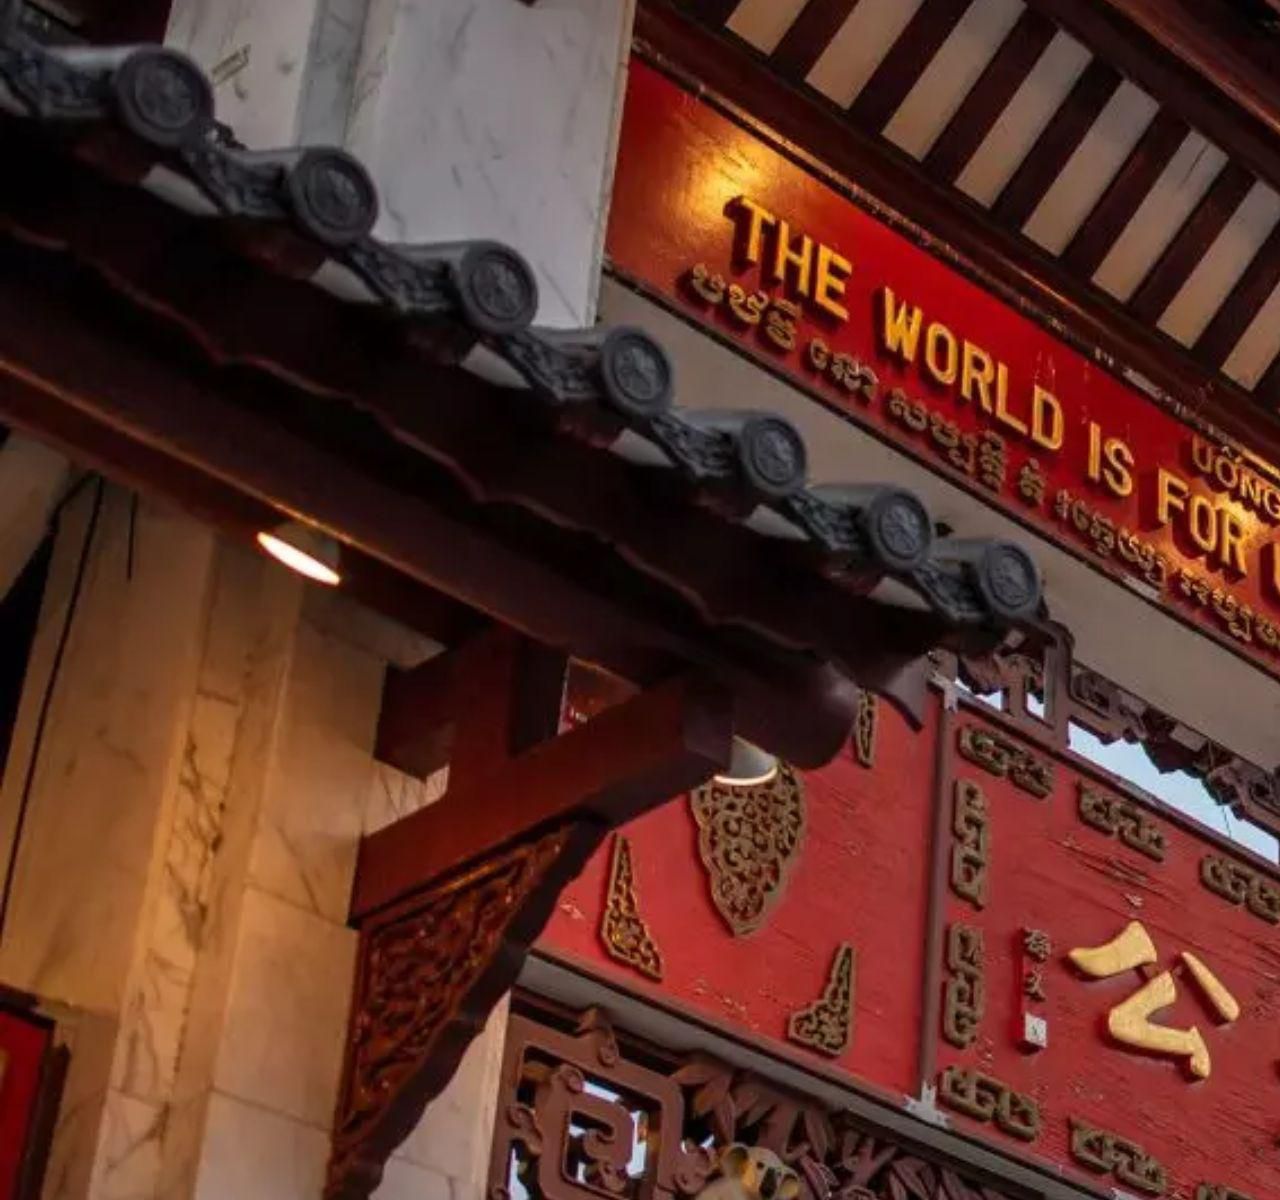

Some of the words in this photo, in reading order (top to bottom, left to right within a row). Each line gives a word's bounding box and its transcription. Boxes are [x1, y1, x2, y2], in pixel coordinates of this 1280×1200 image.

[735, 197, 853, 320] THE
[884, 286, 1065, 450] WORLD
[1086, 421, 1133, 496] IS
[1157, 468, 1247, 576] FOR
